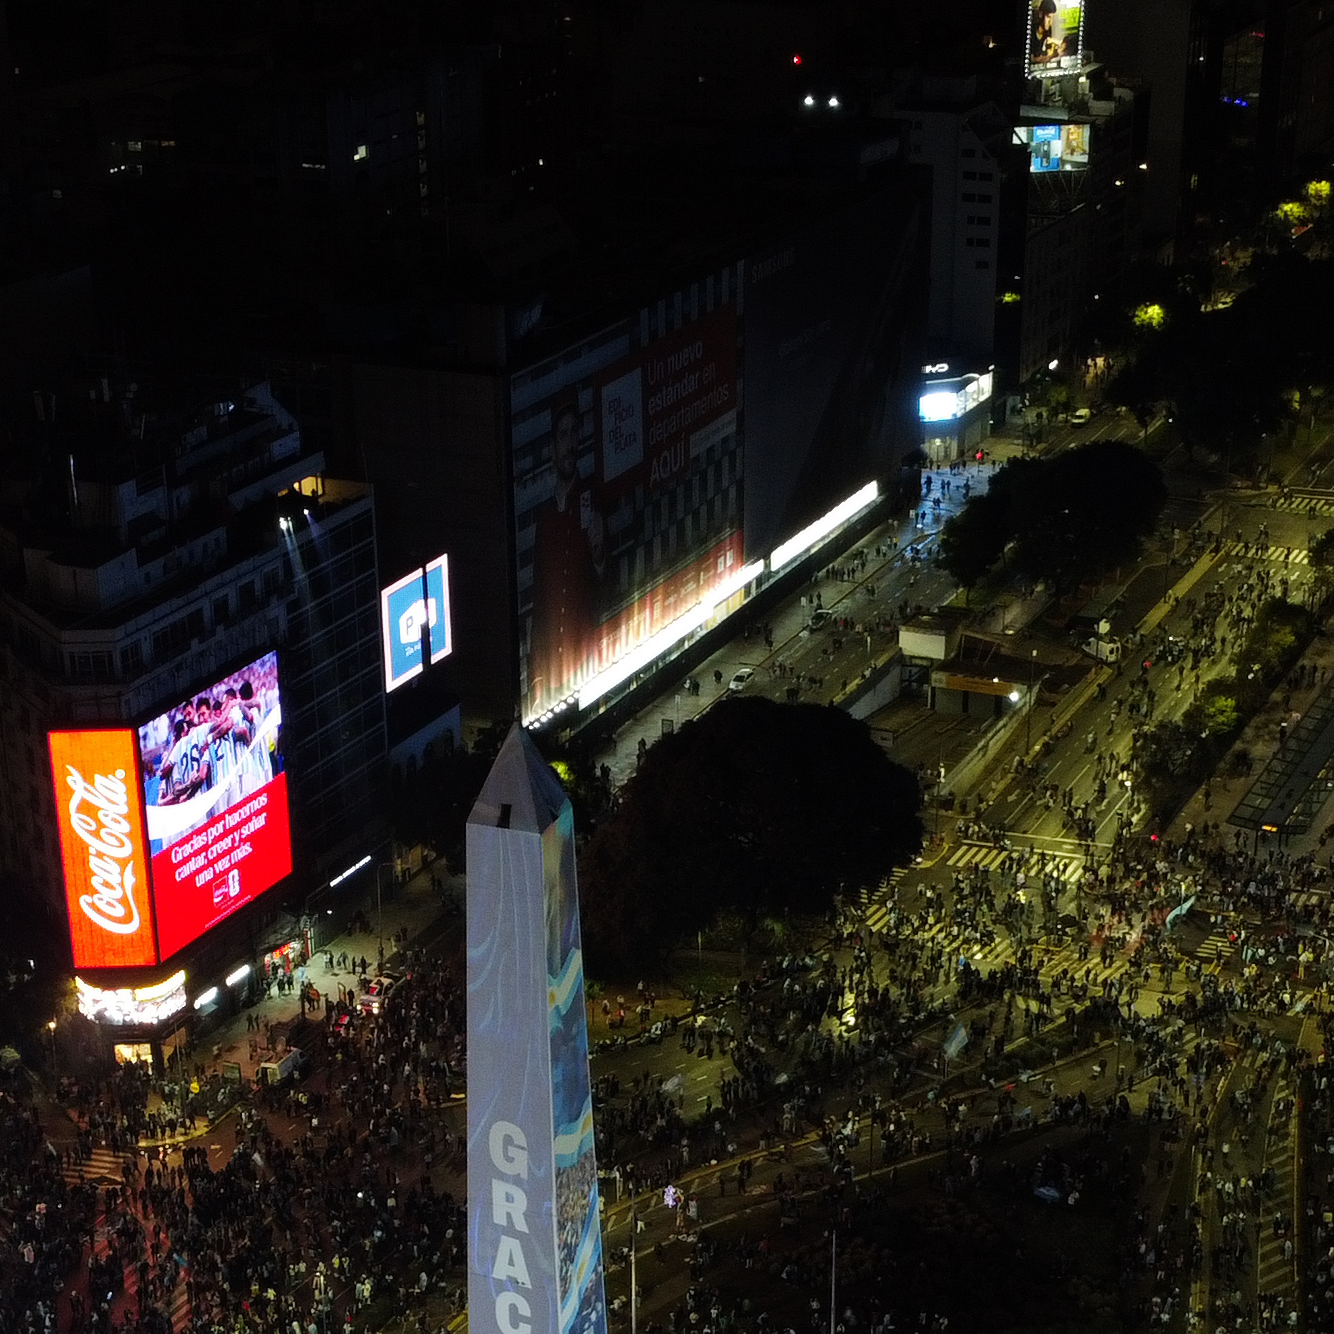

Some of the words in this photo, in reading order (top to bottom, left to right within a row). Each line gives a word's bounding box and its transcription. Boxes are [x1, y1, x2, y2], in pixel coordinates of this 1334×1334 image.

[751, 246, 795, 284] SAMSUNG
[667, 341, 703, 375] nuevo
[649, 383, 730, 446] departamentos
[171, 831, 207, 864] Gracias
[208, 819, 225, 845] por
[175, 850, 208, 883] cantar,
[208, 833, 234, 862] creer
[195, 866, 214, 888] una
[214, 855, 231, 874] vez
